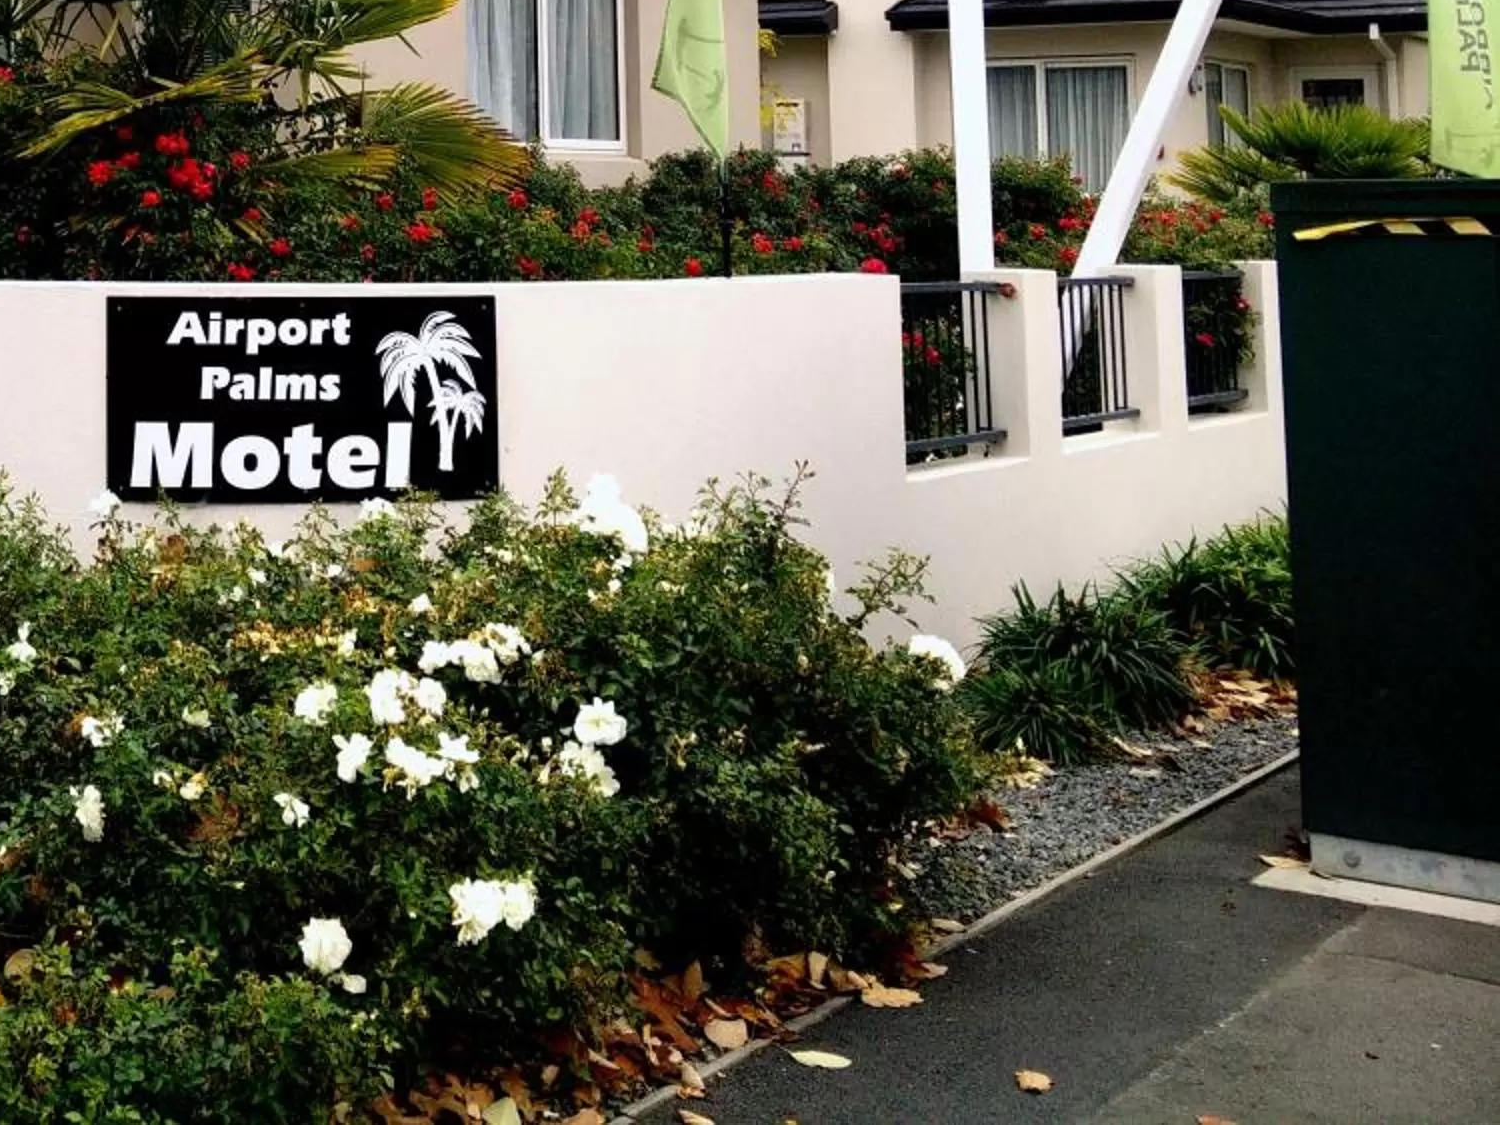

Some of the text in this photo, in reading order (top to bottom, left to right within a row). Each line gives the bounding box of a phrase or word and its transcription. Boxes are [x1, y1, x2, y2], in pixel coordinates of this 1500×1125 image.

[166, 311, 351, 355] Airport
[200, 366, 341, 401] Palms
[130, 421, 413, 490] Motel
